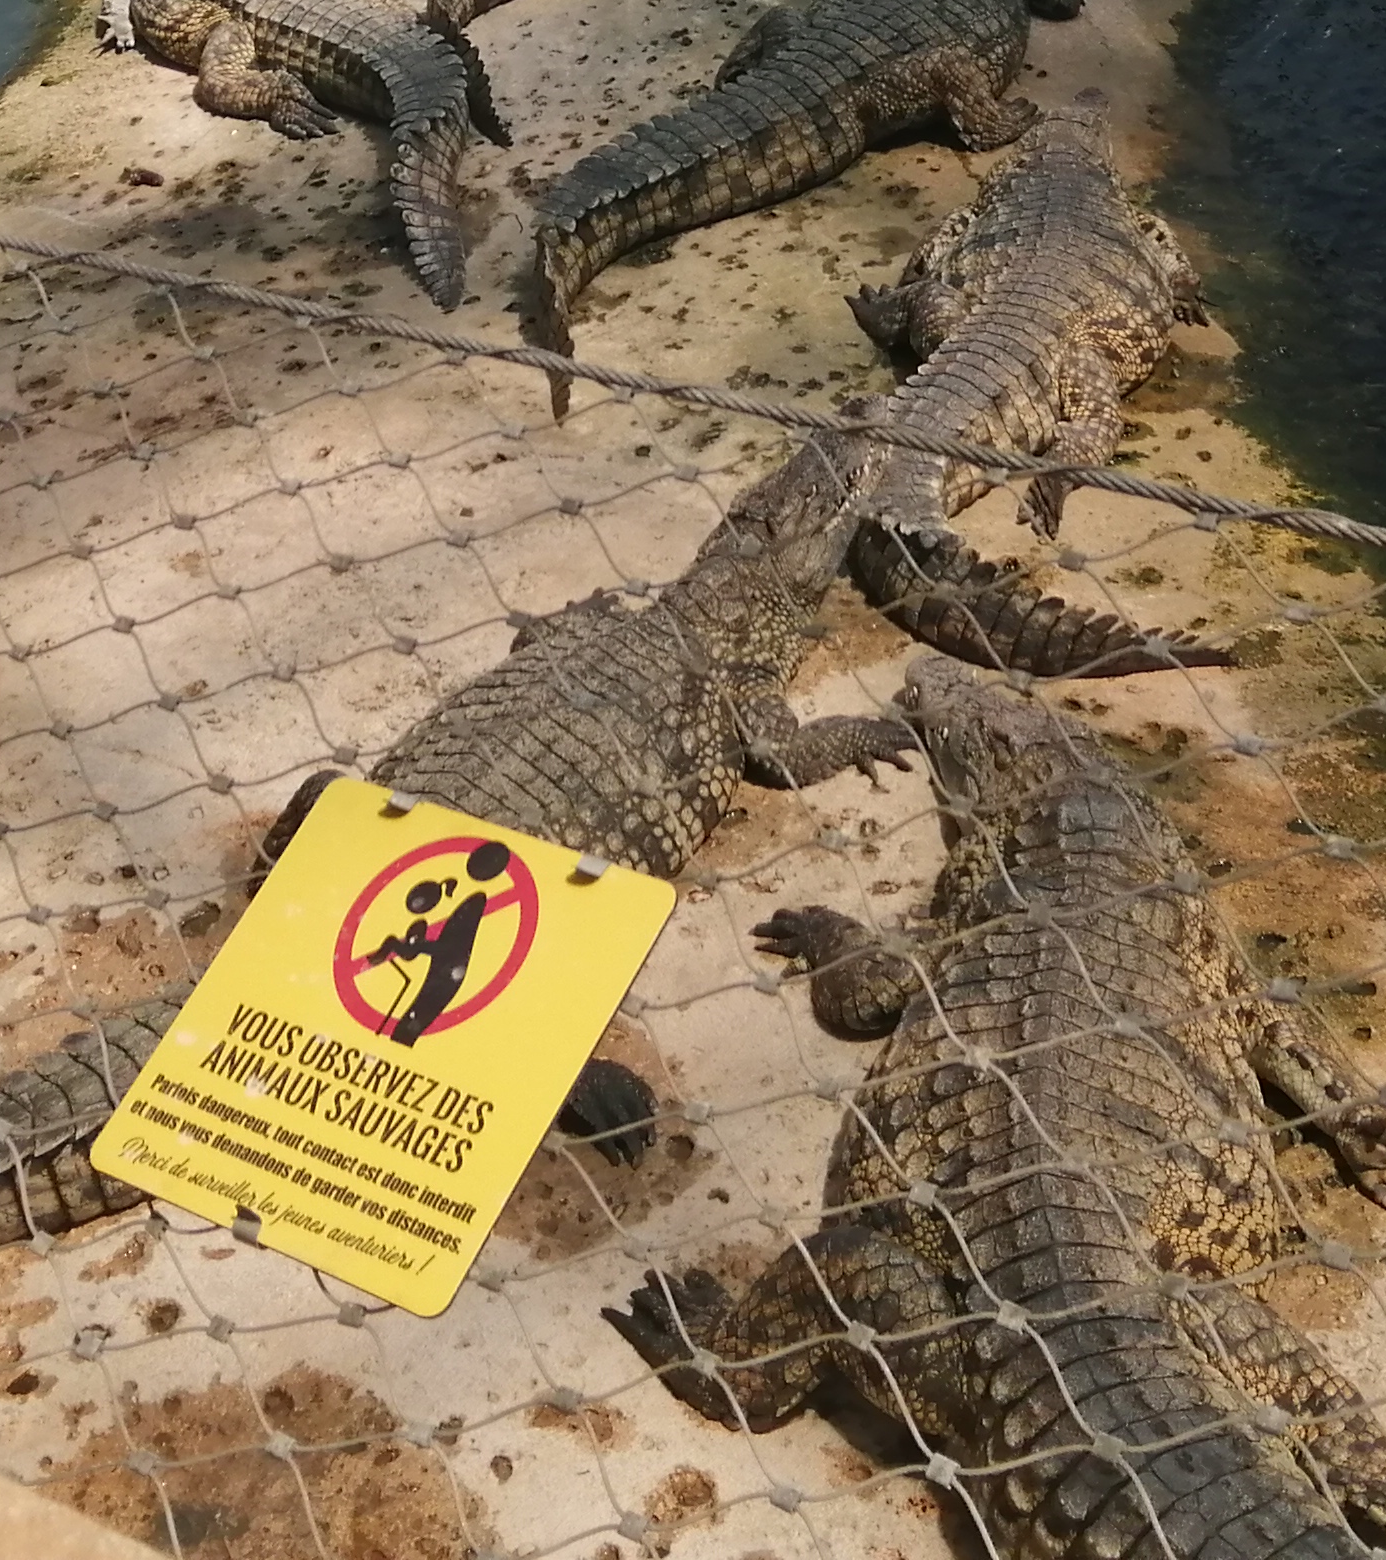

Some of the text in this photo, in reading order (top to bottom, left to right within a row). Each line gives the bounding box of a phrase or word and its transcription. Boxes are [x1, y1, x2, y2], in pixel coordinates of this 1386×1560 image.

[199, 1041, 472, 1173] ANIMAUX SAUVAGES
[227, 1004, 494, 1135] VOUS OBSERVEZ DES
[118, 1137, 173, 1171] Merci
[168, 1158, 191, 1179] de
[187, 1170, 256, 1208] surveiller
[257, 1192, 279, 1215] les
[269, 1204, 326, 1235] jeunes
[326, 1226, 416, 1270] aventuriers
[130, 1099, 462, 1254] et nous vous demandons de garder vos distances.
[150, 1073, 477, 1224] Parfois dangereux, tout contact est donc interdit
